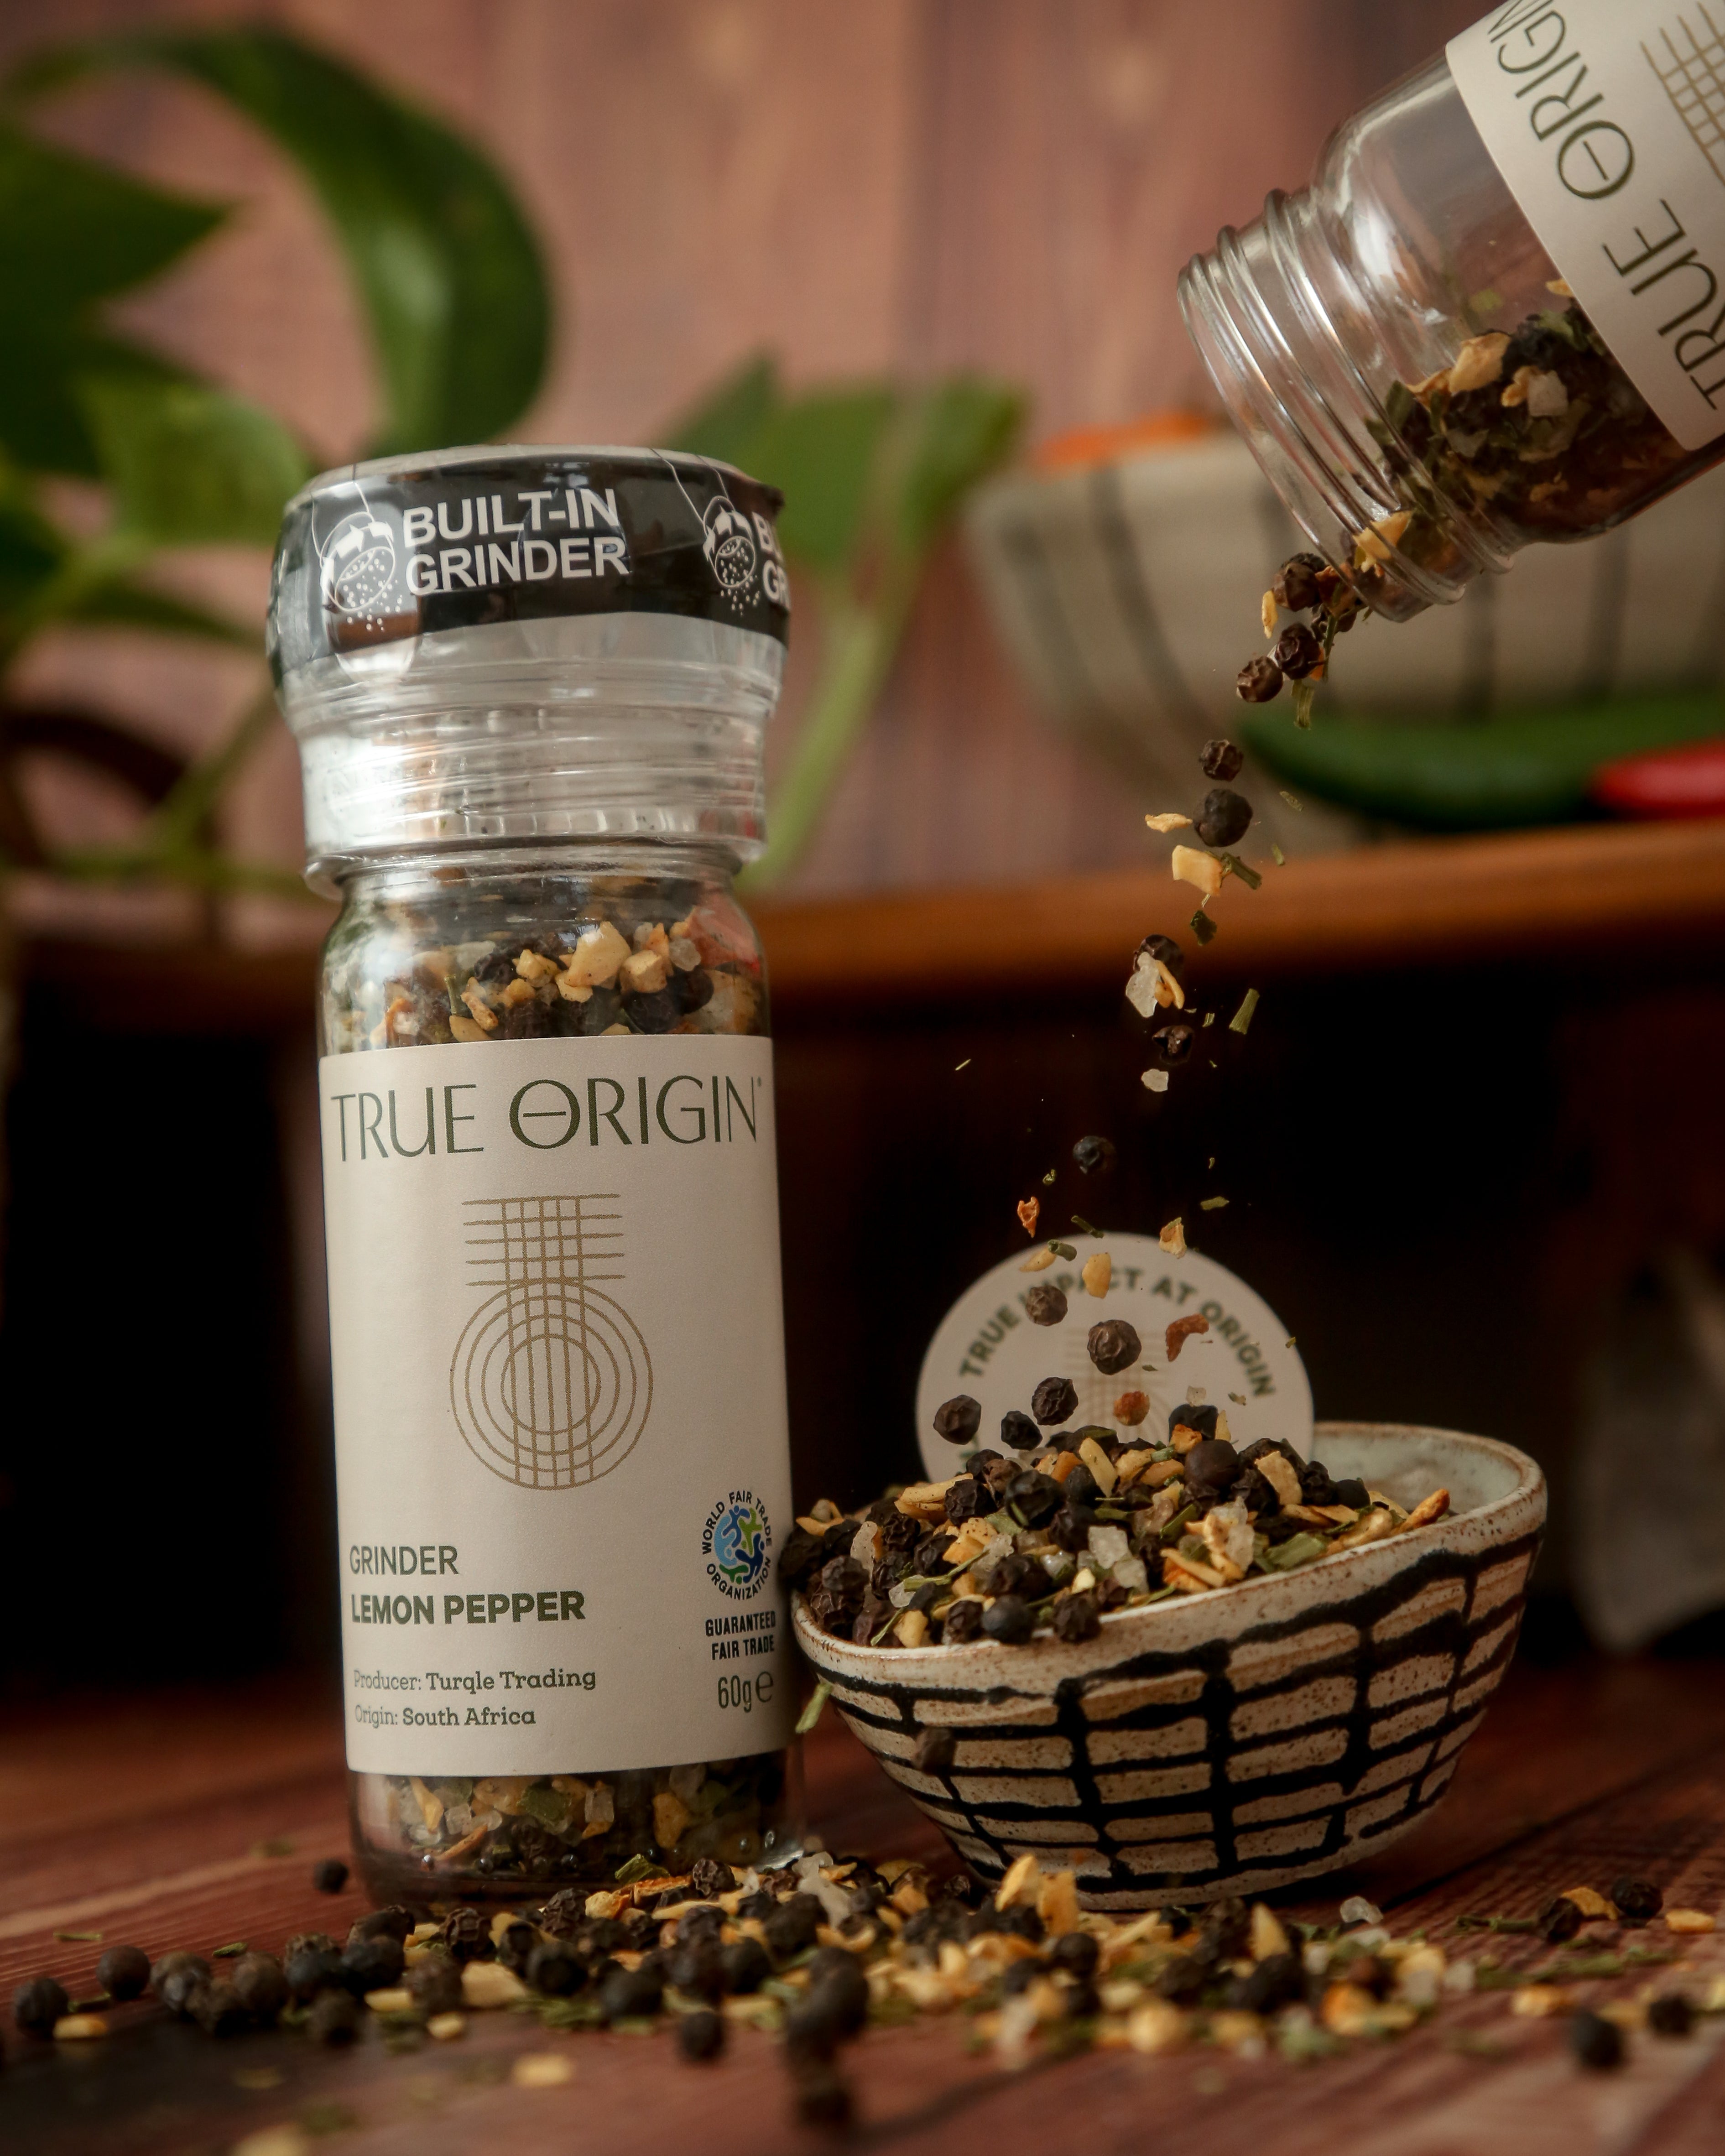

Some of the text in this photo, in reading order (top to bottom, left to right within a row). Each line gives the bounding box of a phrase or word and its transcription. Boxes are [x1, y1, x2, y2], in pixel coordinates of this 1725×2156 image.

[403, 488, 619, 548] BUILT-IN
[406, 536, 630, 596] GRINDER
[331, 1075, 757, 1161] TRUE ORIGIN
[959, 1306, 1021, 1377] TRUE
[1152, 1275, 1197, 1305] AT
[1200, 1301, 1276, 1397] ORIGIN
[702, 1490, 772, 1555] WORLD FAIR TRADE
[349, 1545, 459, 1576] GRINDER
[706, 1556, 771, 1601] ORGANIZATION
[351, 1590, 586, 1625] LEMON PEPPER
[705, 1610, 776, 1637] GUARANTEED
[712, 1634, 775, 1661] FAIR TRADE
[353, 1668, 596, 1695] Producer: Turqle Trading
[355, 1704, 537, 1729] Origin: South Africa
